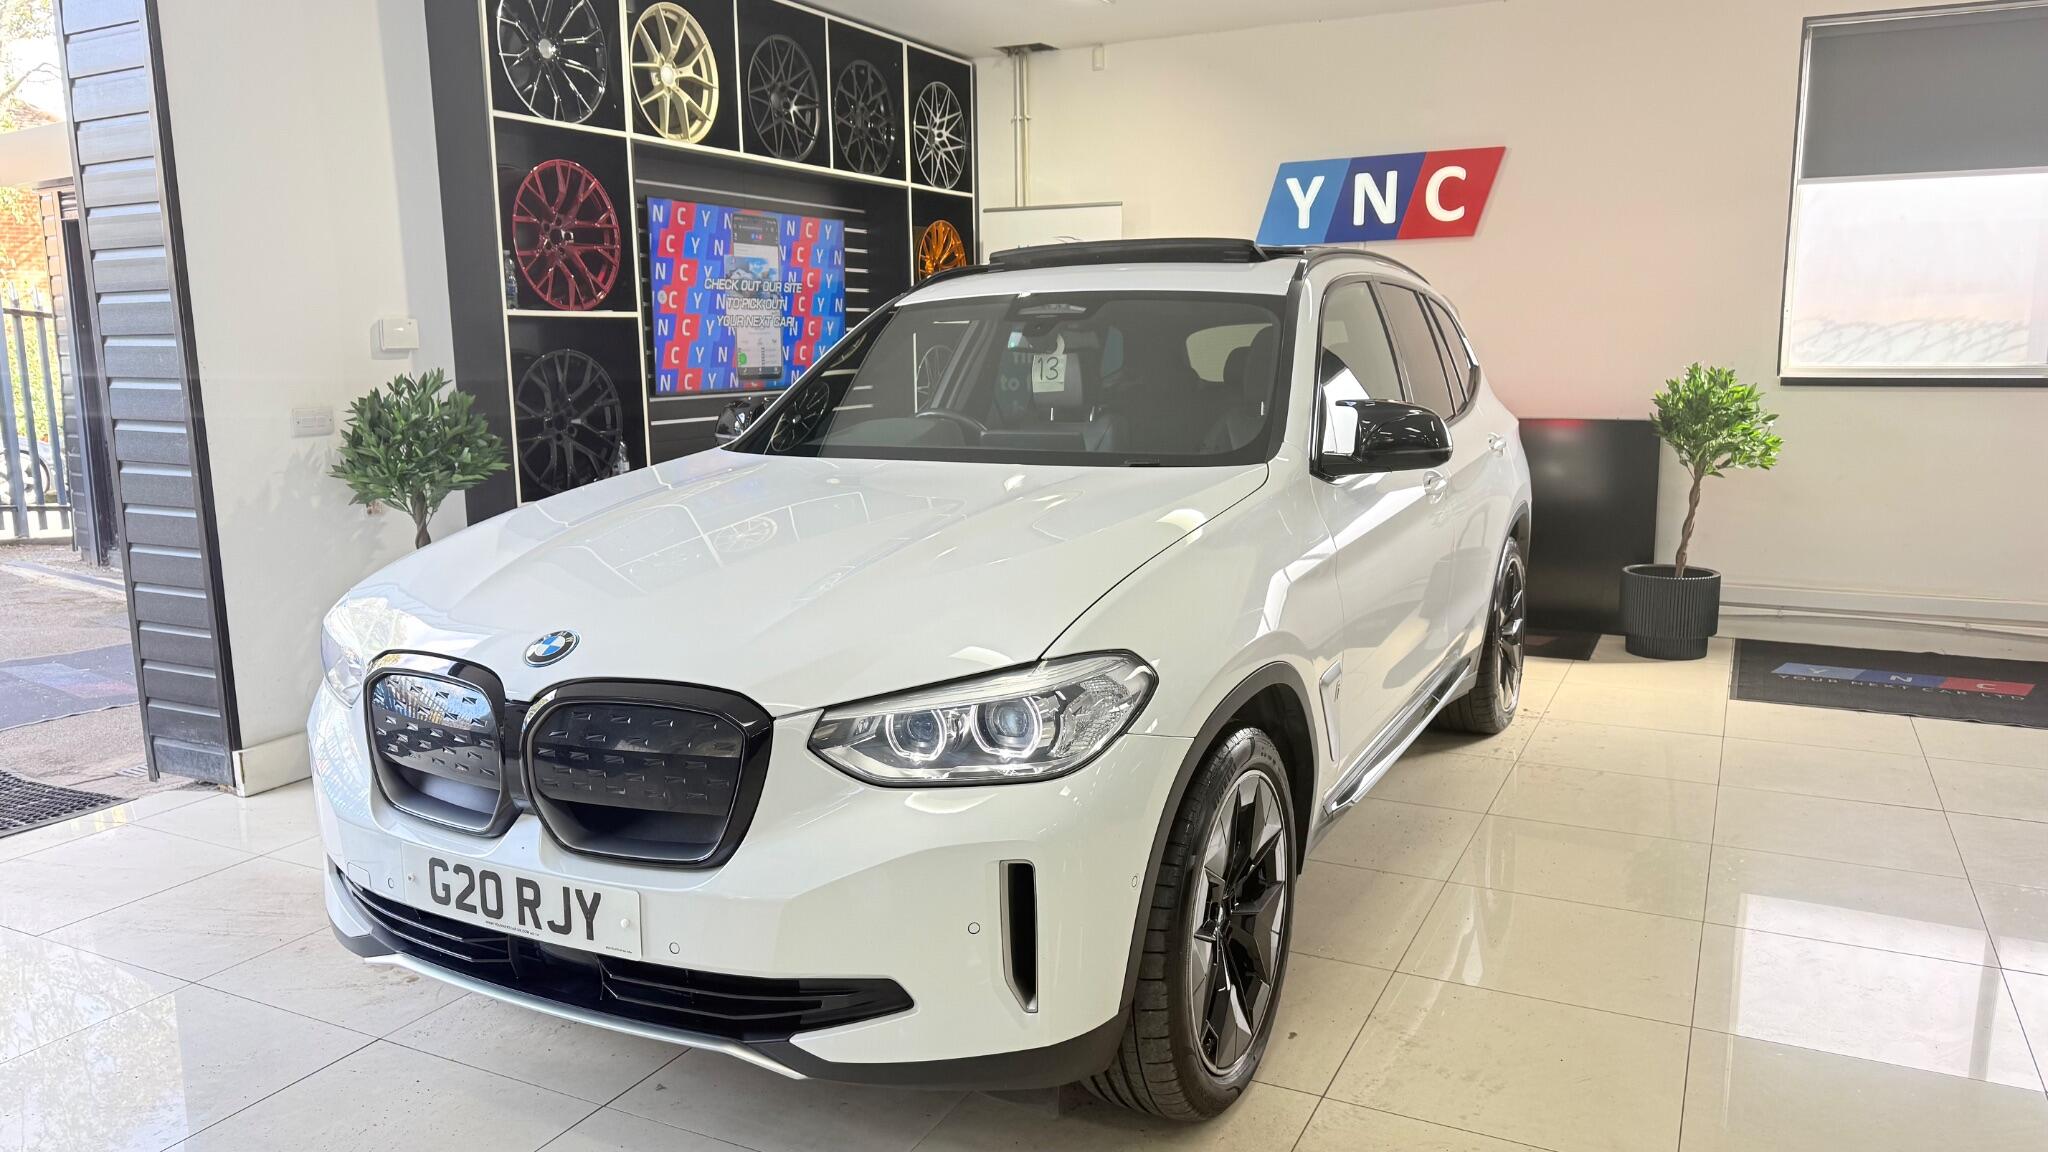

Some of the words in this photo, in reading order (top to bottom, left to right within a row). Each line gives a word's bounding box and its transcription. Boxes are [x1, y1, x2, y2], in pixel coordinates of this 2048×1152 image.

[1286, 165, 1467, 230] YNC
[704, 278, 739, 291] CHECK
[741, 280, 761, 292] OUT
[762, 281, 782, 292] OUR
[783, 282, 803, 294] SITE
[727, 297, 740, 309] TO
[741, 297, 763, 310] PICK
[717, 315, 744, 328] YOUR
[745, 315, 773, 328] NEXT
[1038, 356, 1060, 381] 13
[428, 857, 504, 921] G20
[516, 876, 601, 941] RJY
